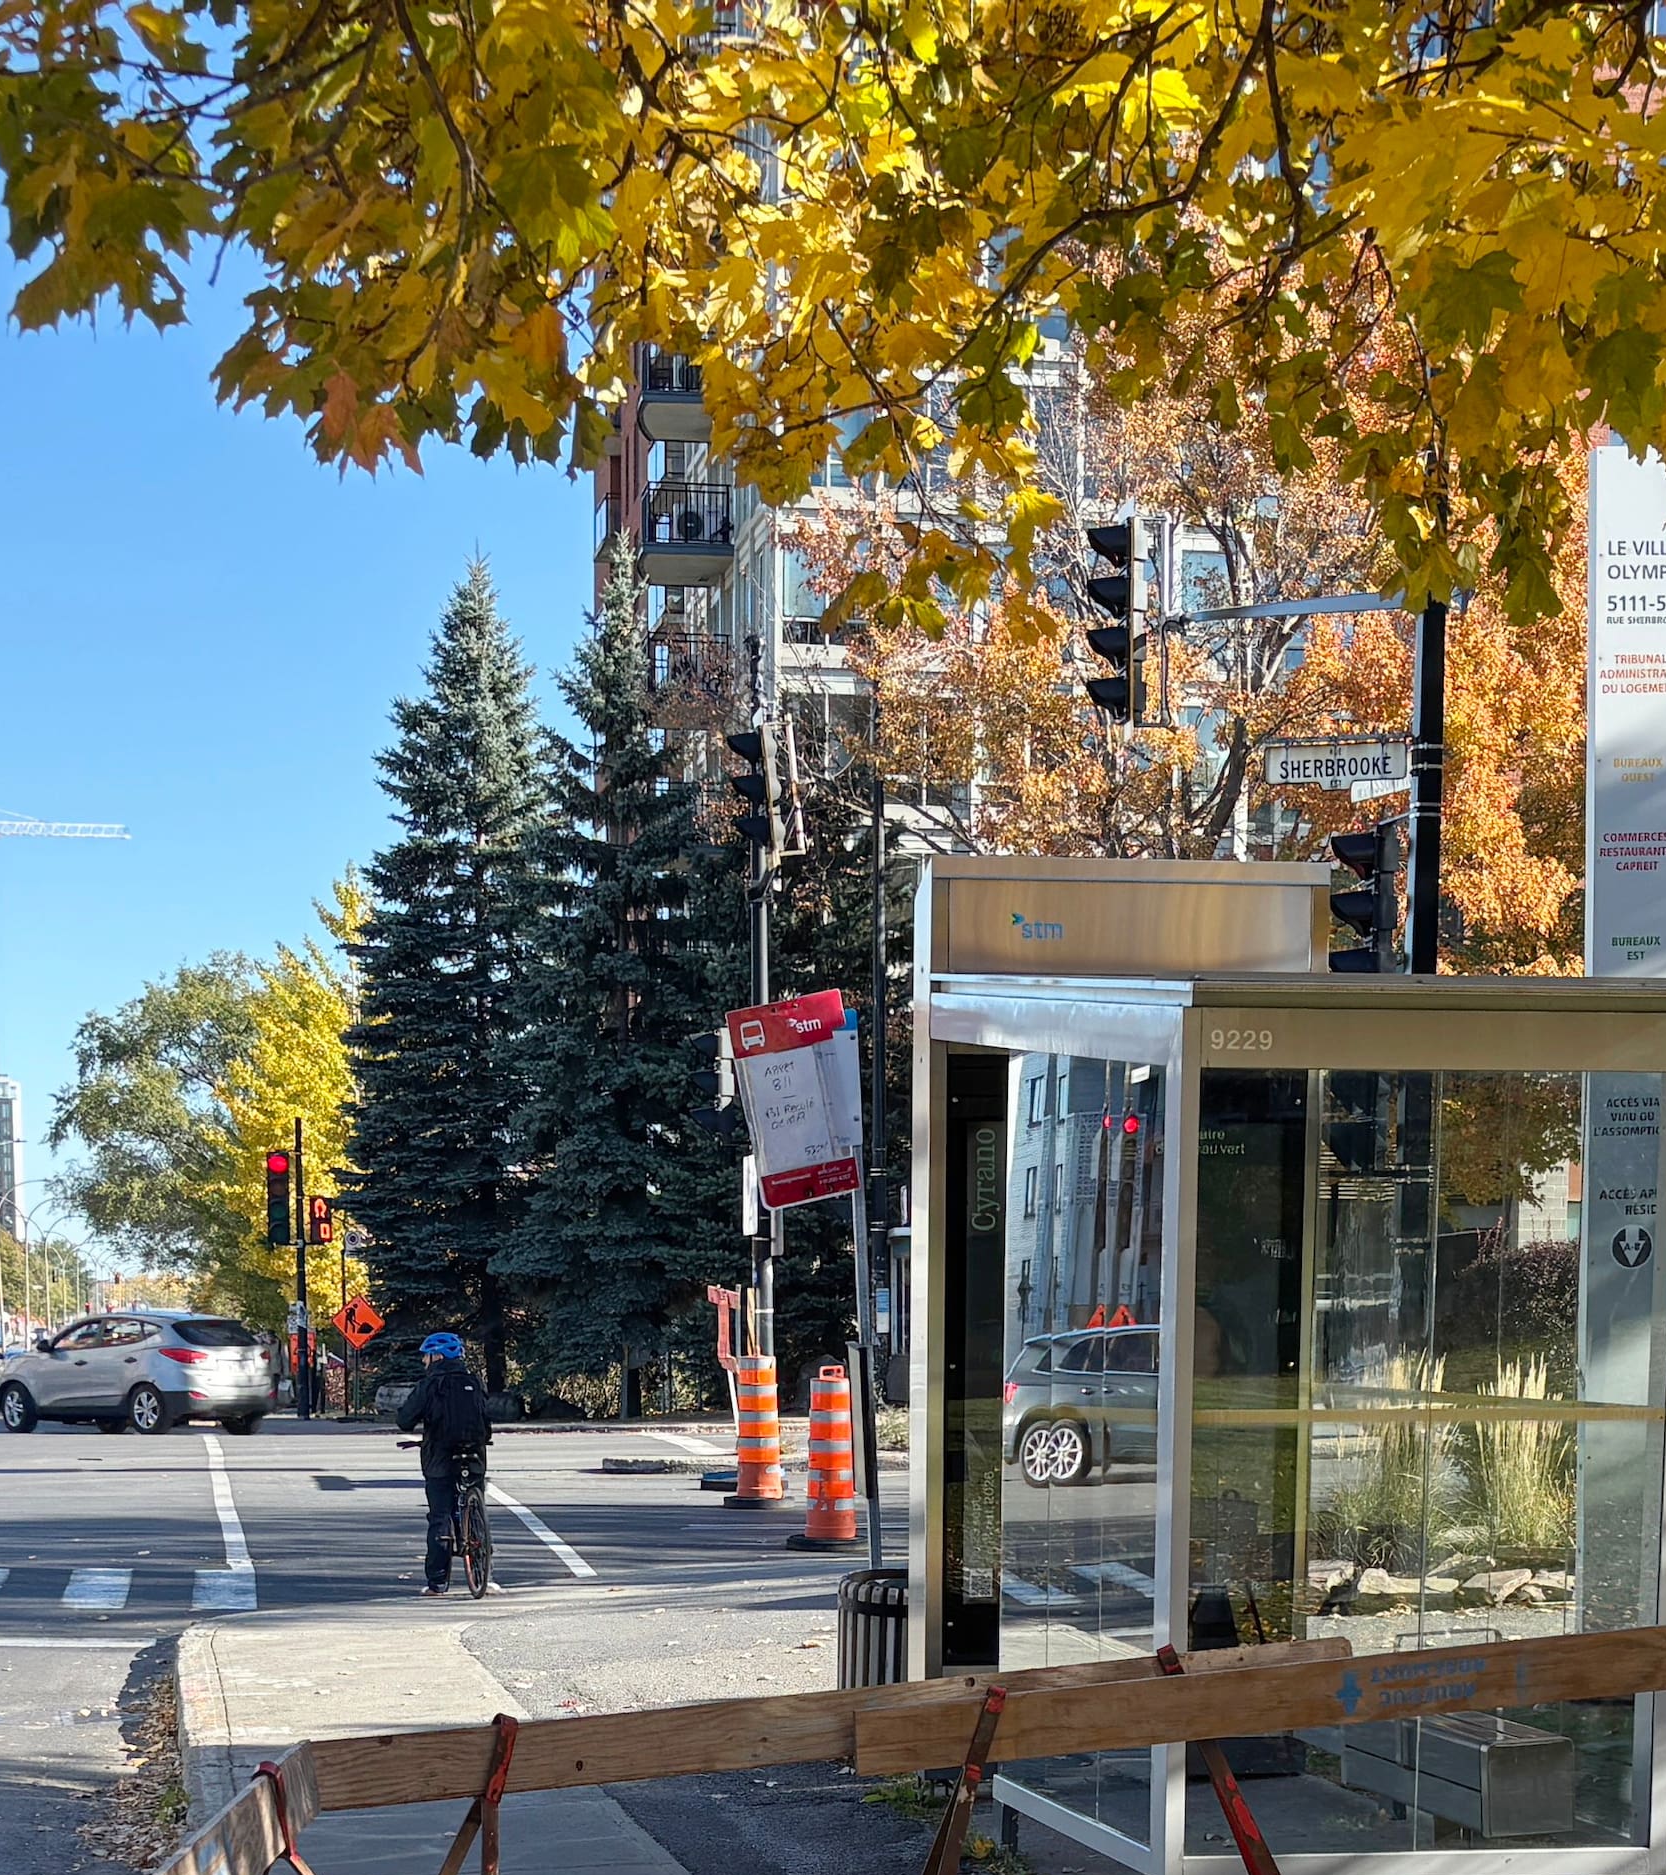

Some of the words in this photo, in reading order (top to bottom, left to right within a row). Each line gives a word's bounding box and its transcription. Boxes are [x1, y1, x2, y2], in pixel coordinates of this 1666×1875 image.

[1607, 540, 1626, 556] LE
[1606, 616, 1624, 625] RUE
[1602, 684, 1618, 694] DU
[1279, 756, 1392, 779] SHERBROOKE
[1613, 757, 1663, 768] BUREAUX
[1615, 861, 1659, 871] CAPREIT
[1021, 920, 1063, 940] stm
[1611, 936, 1661, 947] BUREAUX
[1627, 951, 1645, 961] EST
[795, 1017, 822, 1034] stm
[1210, 1029, 1273, 1050] 9229
[1605, 1096, 1639, 1108] ACCÈS
[1642, 1097, 1660, 1107] VIA
[1610, 1112, 1636, 1121] VIAU
[1639, 1111, 1655, 1121] OU
[1219, 1143, 1245, 1155] vert
[971, 1128, 1000, 1231] Cyrano
[1599, 1188, 1636, 1200] ACCÈS
